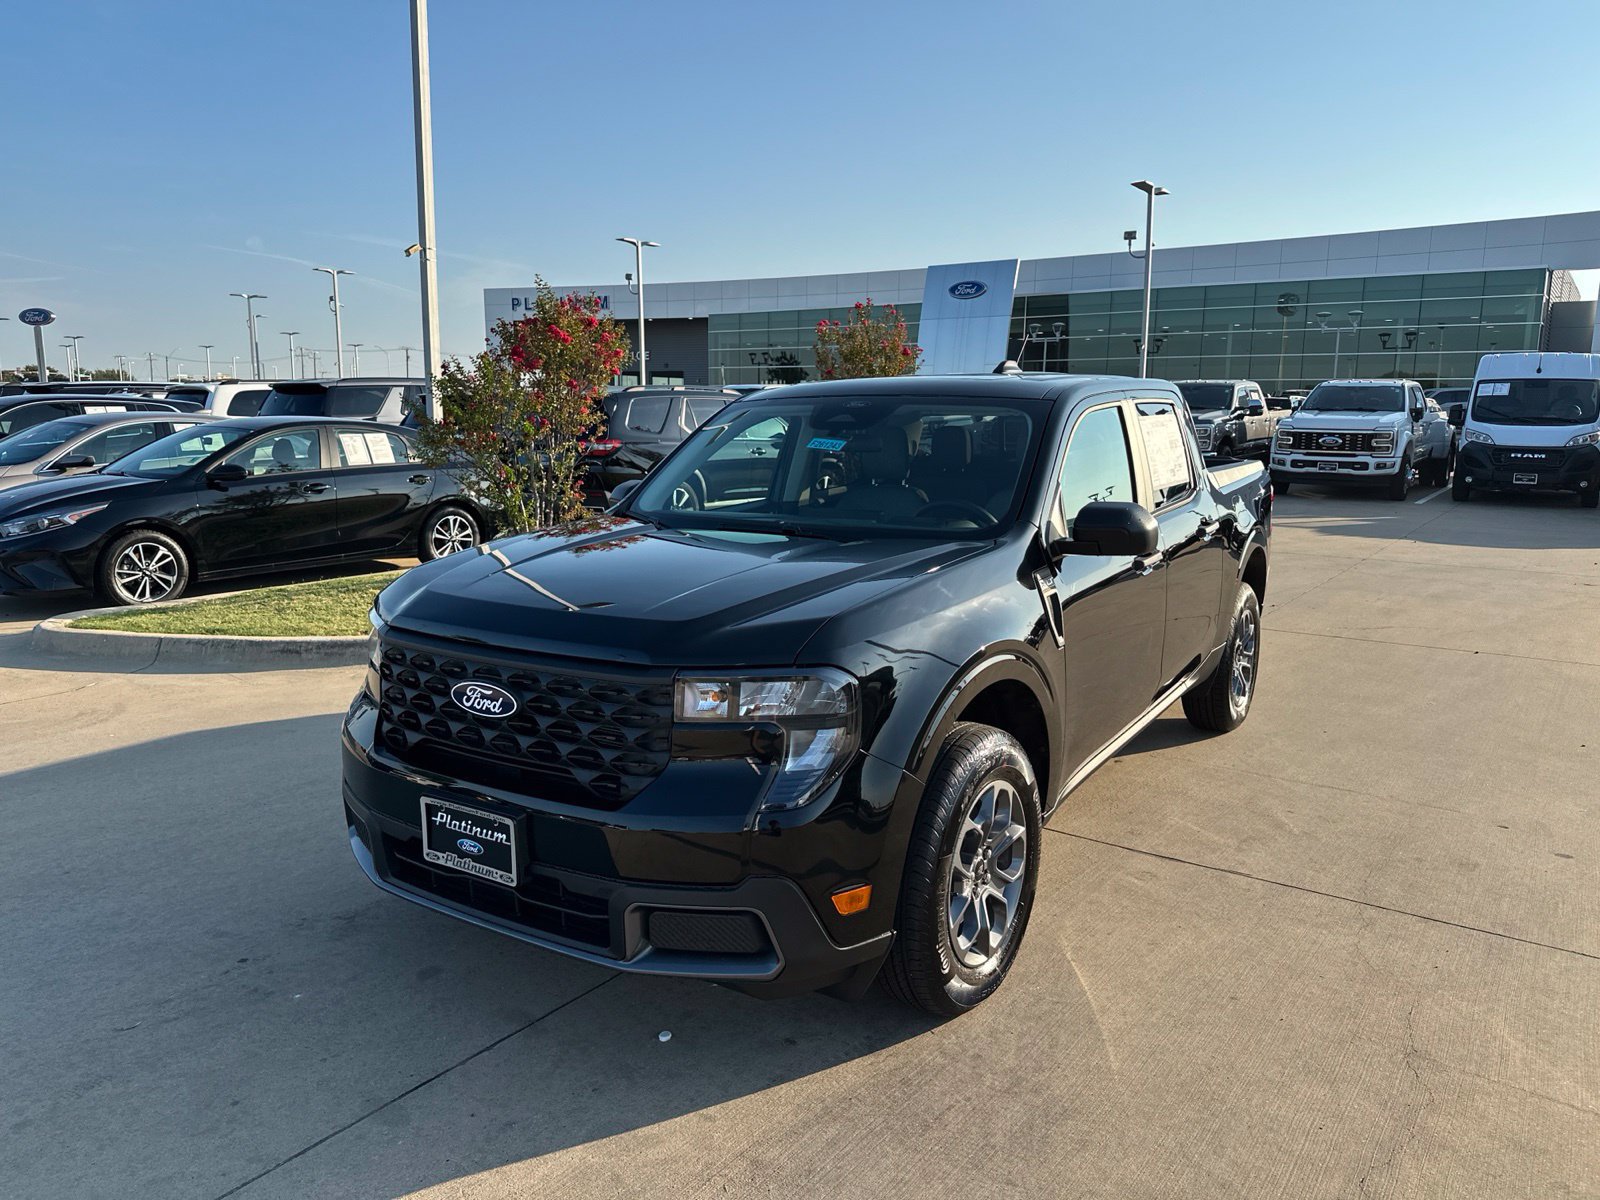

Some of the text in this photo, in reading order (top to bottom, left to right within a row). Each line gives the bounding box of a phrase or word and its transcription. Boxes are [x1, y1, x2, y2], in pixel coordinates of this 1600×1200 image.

[954, 283, 978, 295] Ford
[24, 311, 45, 322] Ford
[462, 685, 503, 713] Ford
[431, 811, 511, 846] Platinum
[461, 840, 479, 853] Ford
[444, 853, 499, 880] Platinum
